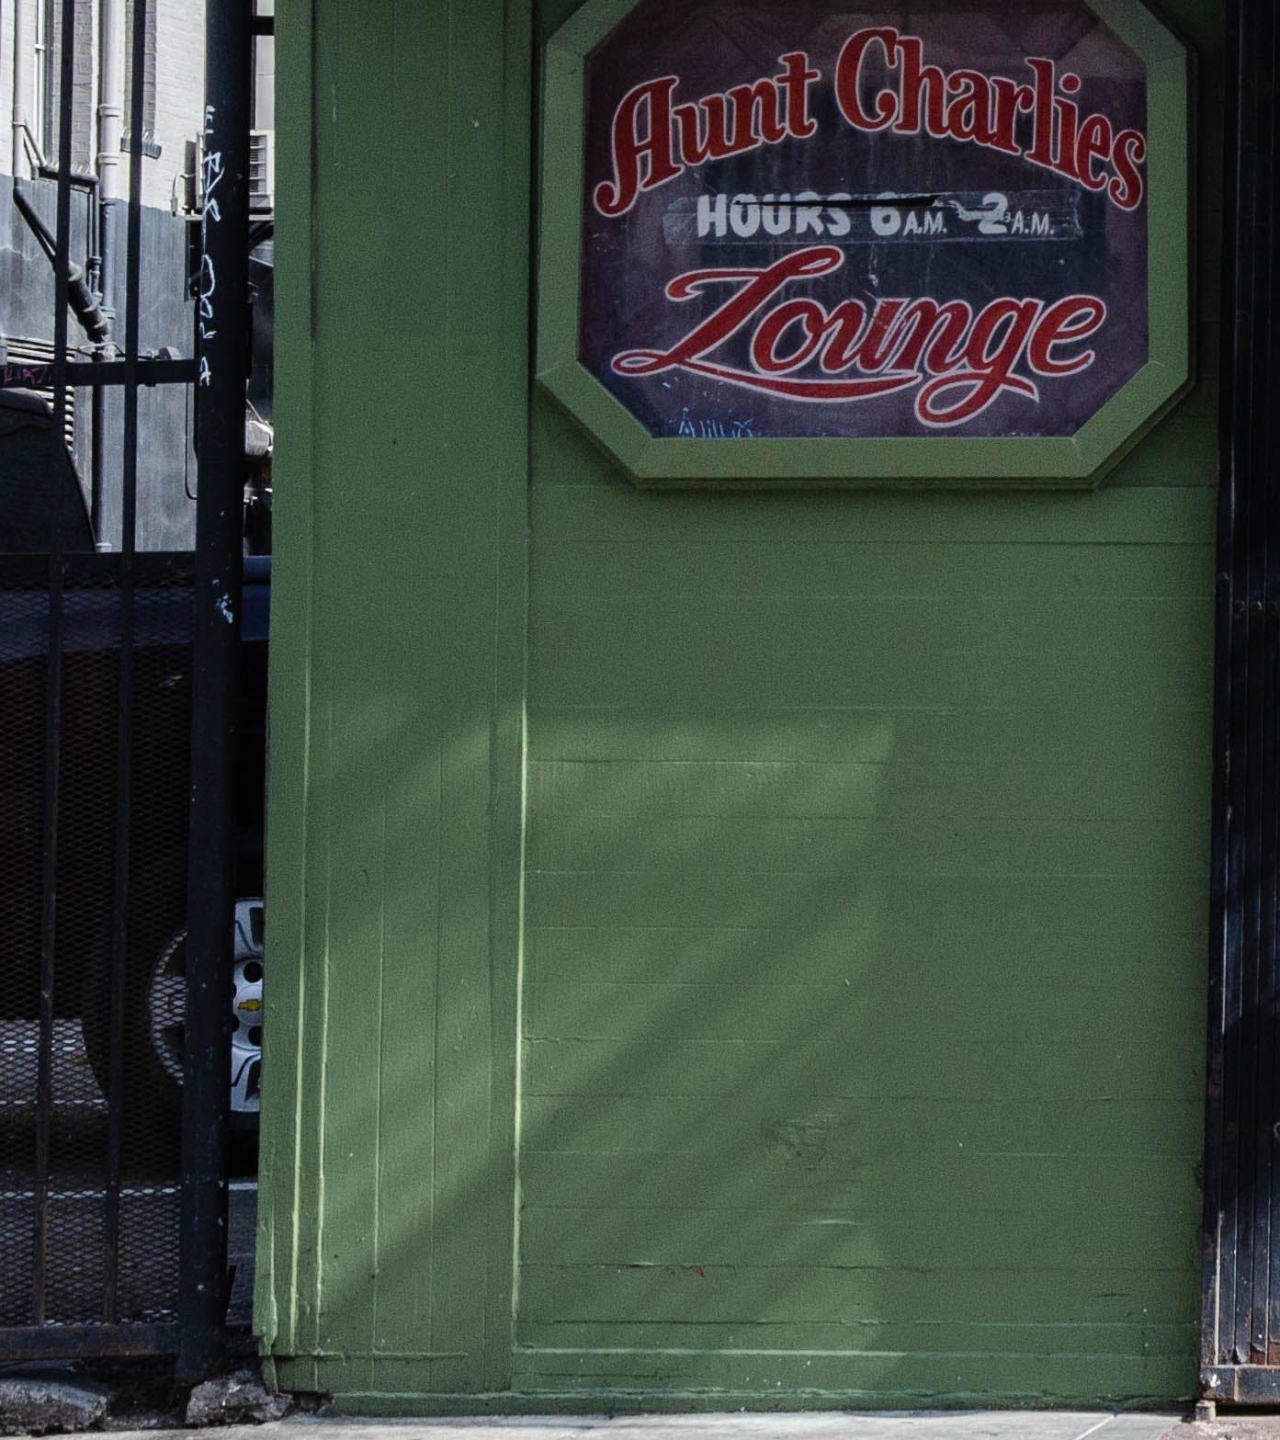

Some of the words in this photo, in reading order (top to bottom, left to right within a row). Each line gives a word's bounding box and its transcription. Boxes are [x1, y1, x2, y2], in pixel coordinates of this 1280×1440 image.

[593, 51, 821, 217] Aunt
[833, 26, 1146, 210] Charlies
[697, 192, 852, 238] HOURS
[611, 245, 1106, 428] Lounge
